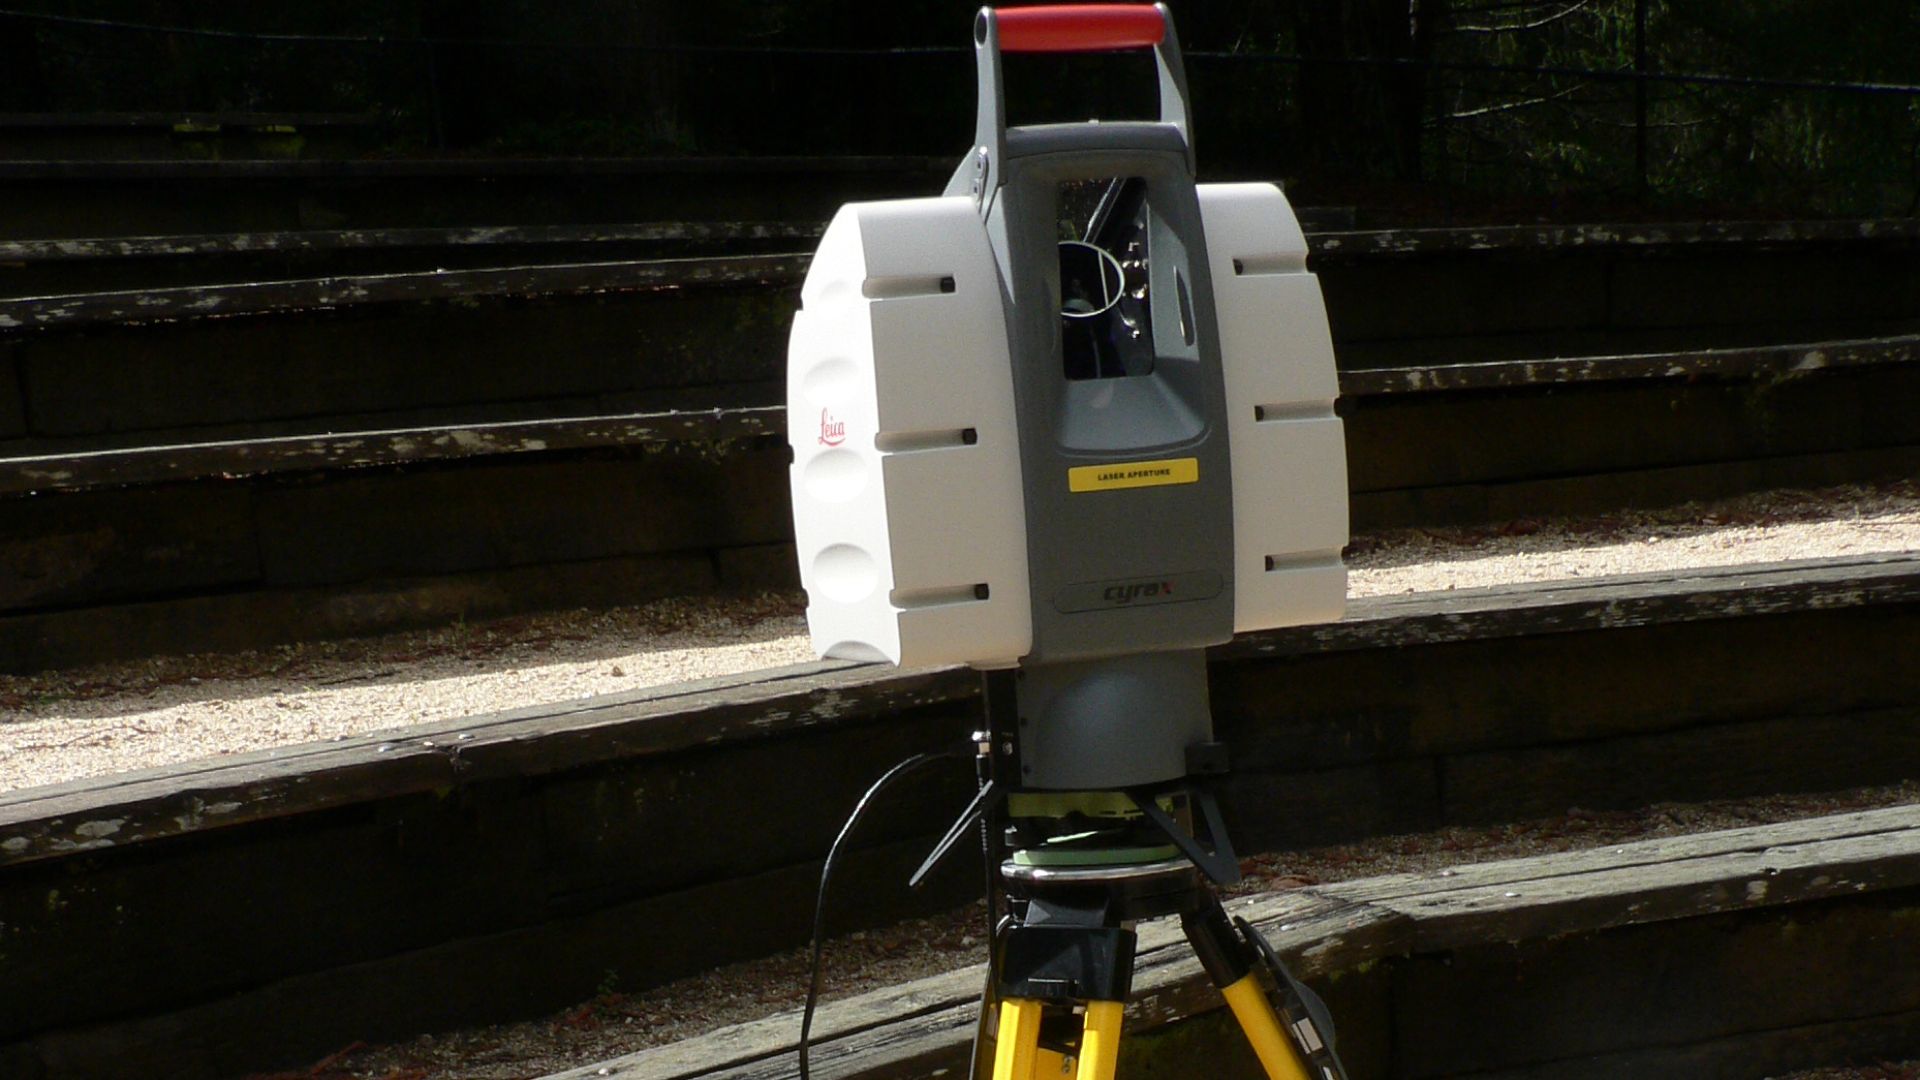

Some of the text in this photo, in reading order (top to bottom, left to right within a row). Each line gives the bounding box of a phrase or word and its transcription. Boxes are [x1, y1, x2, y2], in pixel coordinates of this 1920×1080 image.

[818, 407, 846, 446] Leica
[1097, 468, 1171, 481] LASER APERTURE
